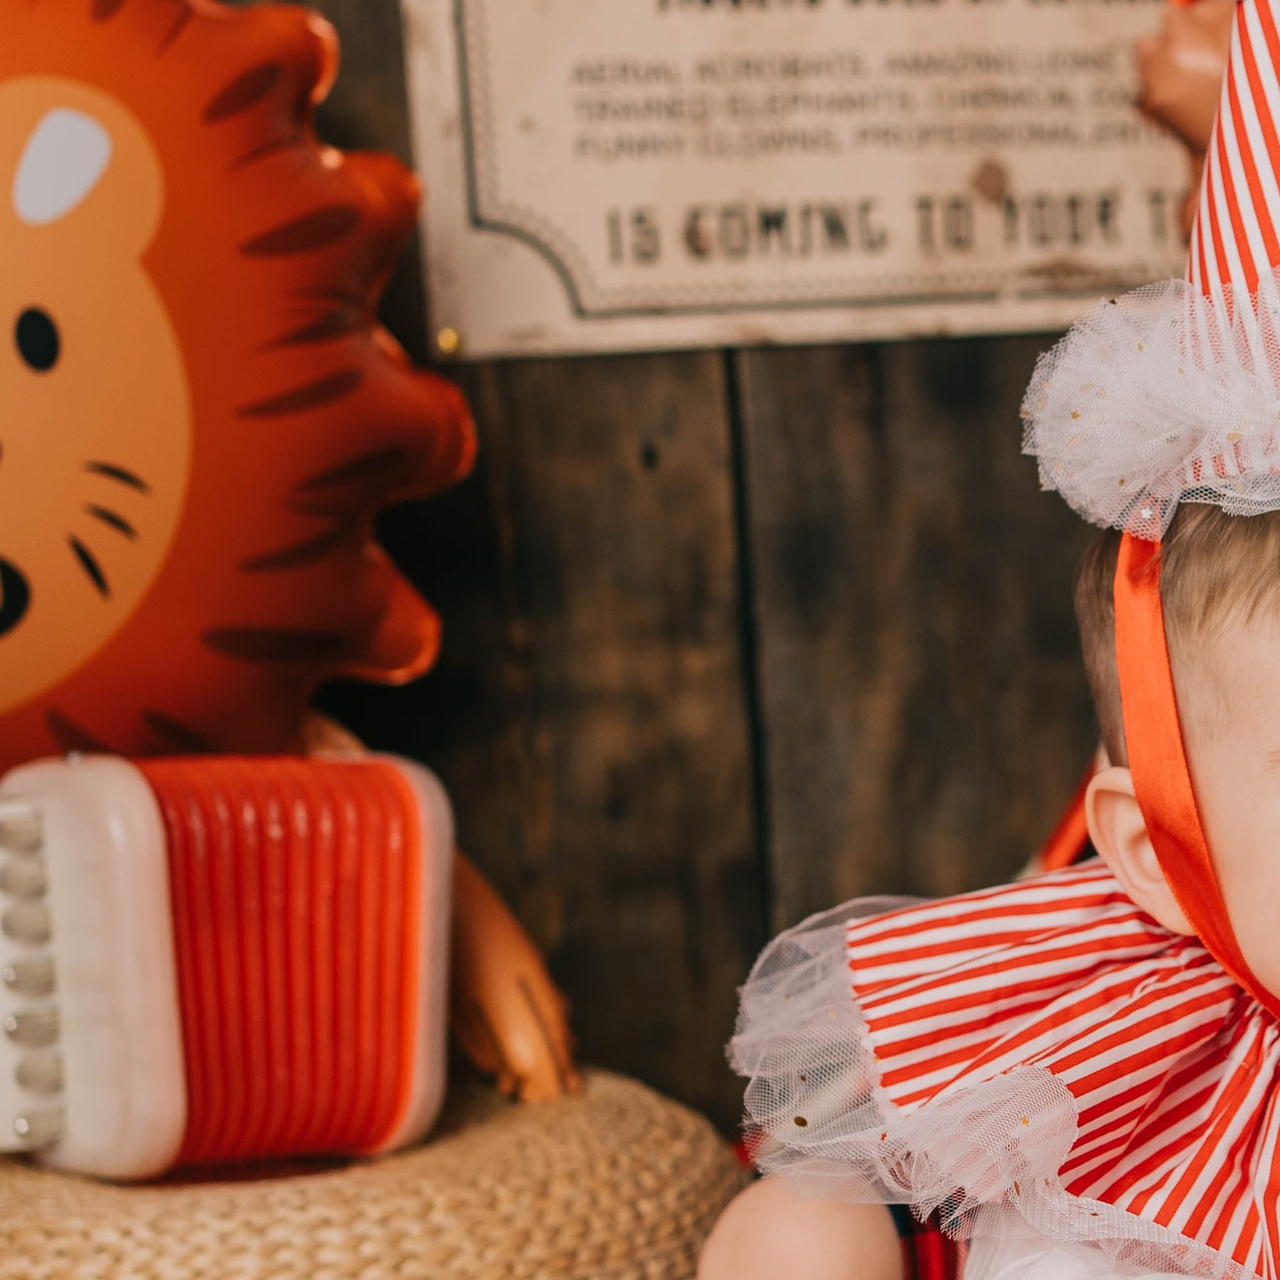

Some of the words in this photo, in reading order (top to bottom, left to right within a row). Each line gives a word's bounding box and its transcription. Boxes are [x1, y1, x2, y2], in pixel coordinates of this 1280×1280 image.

[606, 205, 662, 268] IS
[681, 195, 892, 262] COMING
[912, 194, 972, 255] TO
[1000, 190, 1118, 250] YOUR
